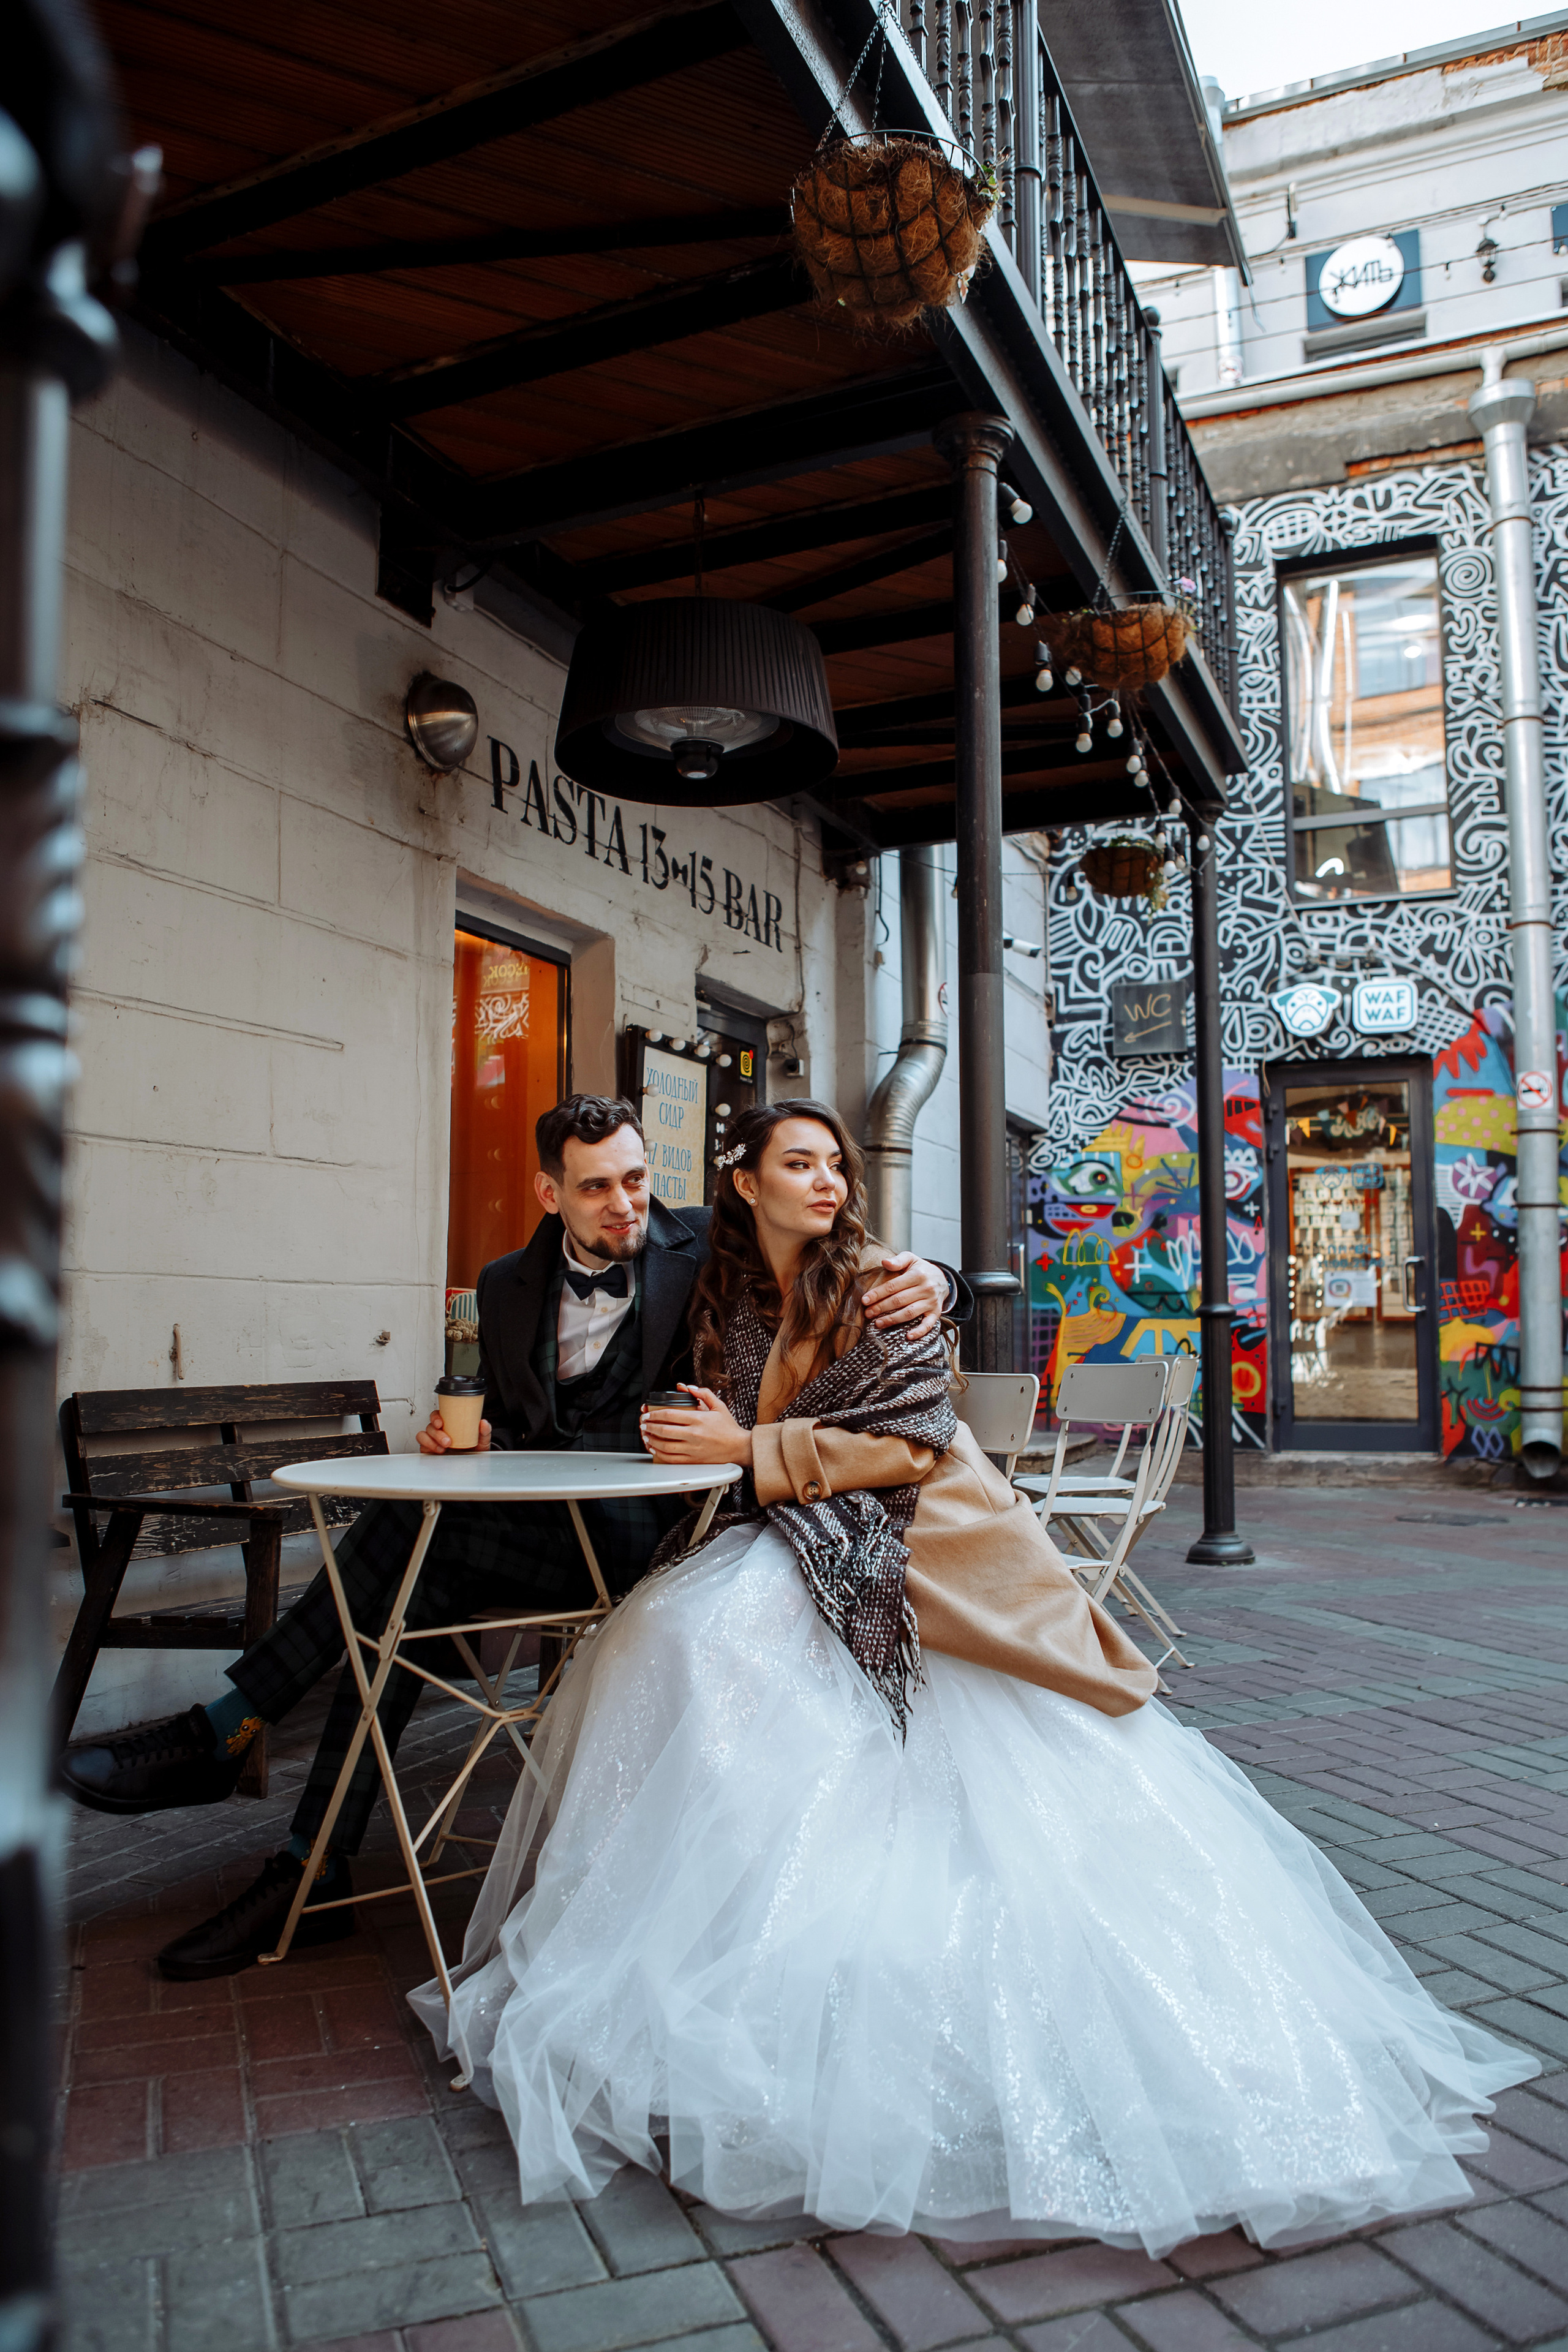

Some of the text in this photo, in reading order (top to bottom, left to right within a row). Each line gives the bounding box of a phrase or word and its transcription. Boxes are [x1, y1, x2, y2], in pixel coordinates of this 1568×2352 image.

[1330, 260, 1392, 290] ЖИТЬ
[487, 736, 632, 876] PASTA
[723, 868, 783, 953] BAR
[1124, 993, 1171, 1021] WC
[1365, 990, 1406, 1004] WAF
[1365, 1007, 1406, 1021] WAF
[647, 1068, 698, 1104] ХОЛОДНЫЙ
[659, 1102, 684, 1129] СИДР
[662, 1144, 692, 1173] ВИДОВ
[654, 1172, 687, 1200] ПАСТЫ
